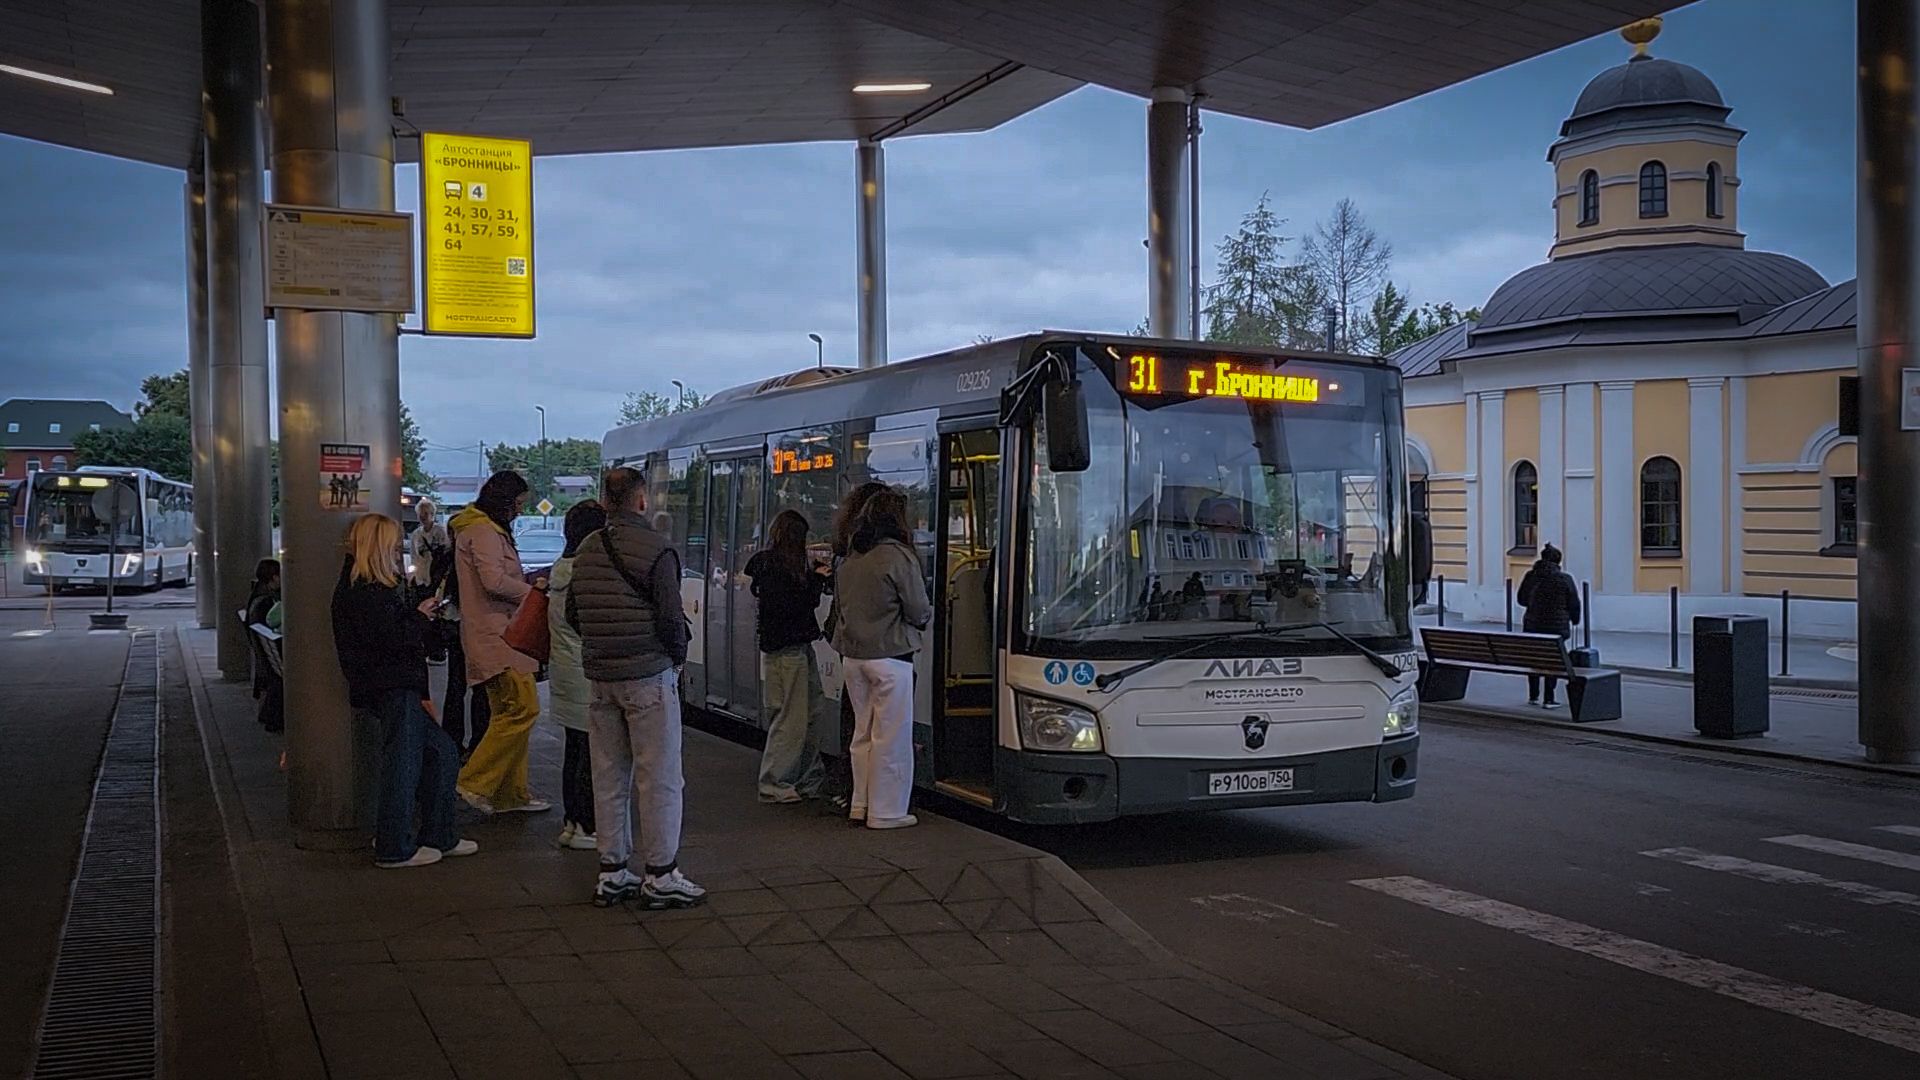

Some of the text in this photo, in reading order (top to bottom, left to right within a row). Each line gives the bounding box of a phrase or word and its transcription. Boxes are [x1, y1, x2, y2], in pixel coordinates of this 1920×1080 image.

[442, 143, 512, 158] Автостанция
[435, 157, 521, 172] «БРОННИЦЫ»
[472, 185, 483, 199] 4
[444, 205, 519, 223] 24, 30, 31,
[444, 222, 519, 240] 41, 57, 59,
[444, 239, 463, 250] 64
[1130, 355, 1157, 392] 31
[1203, 658, 1303, 678] ЛИАЗ
[1205, 687, 1304, 700] МОСТРАНСАВТО
